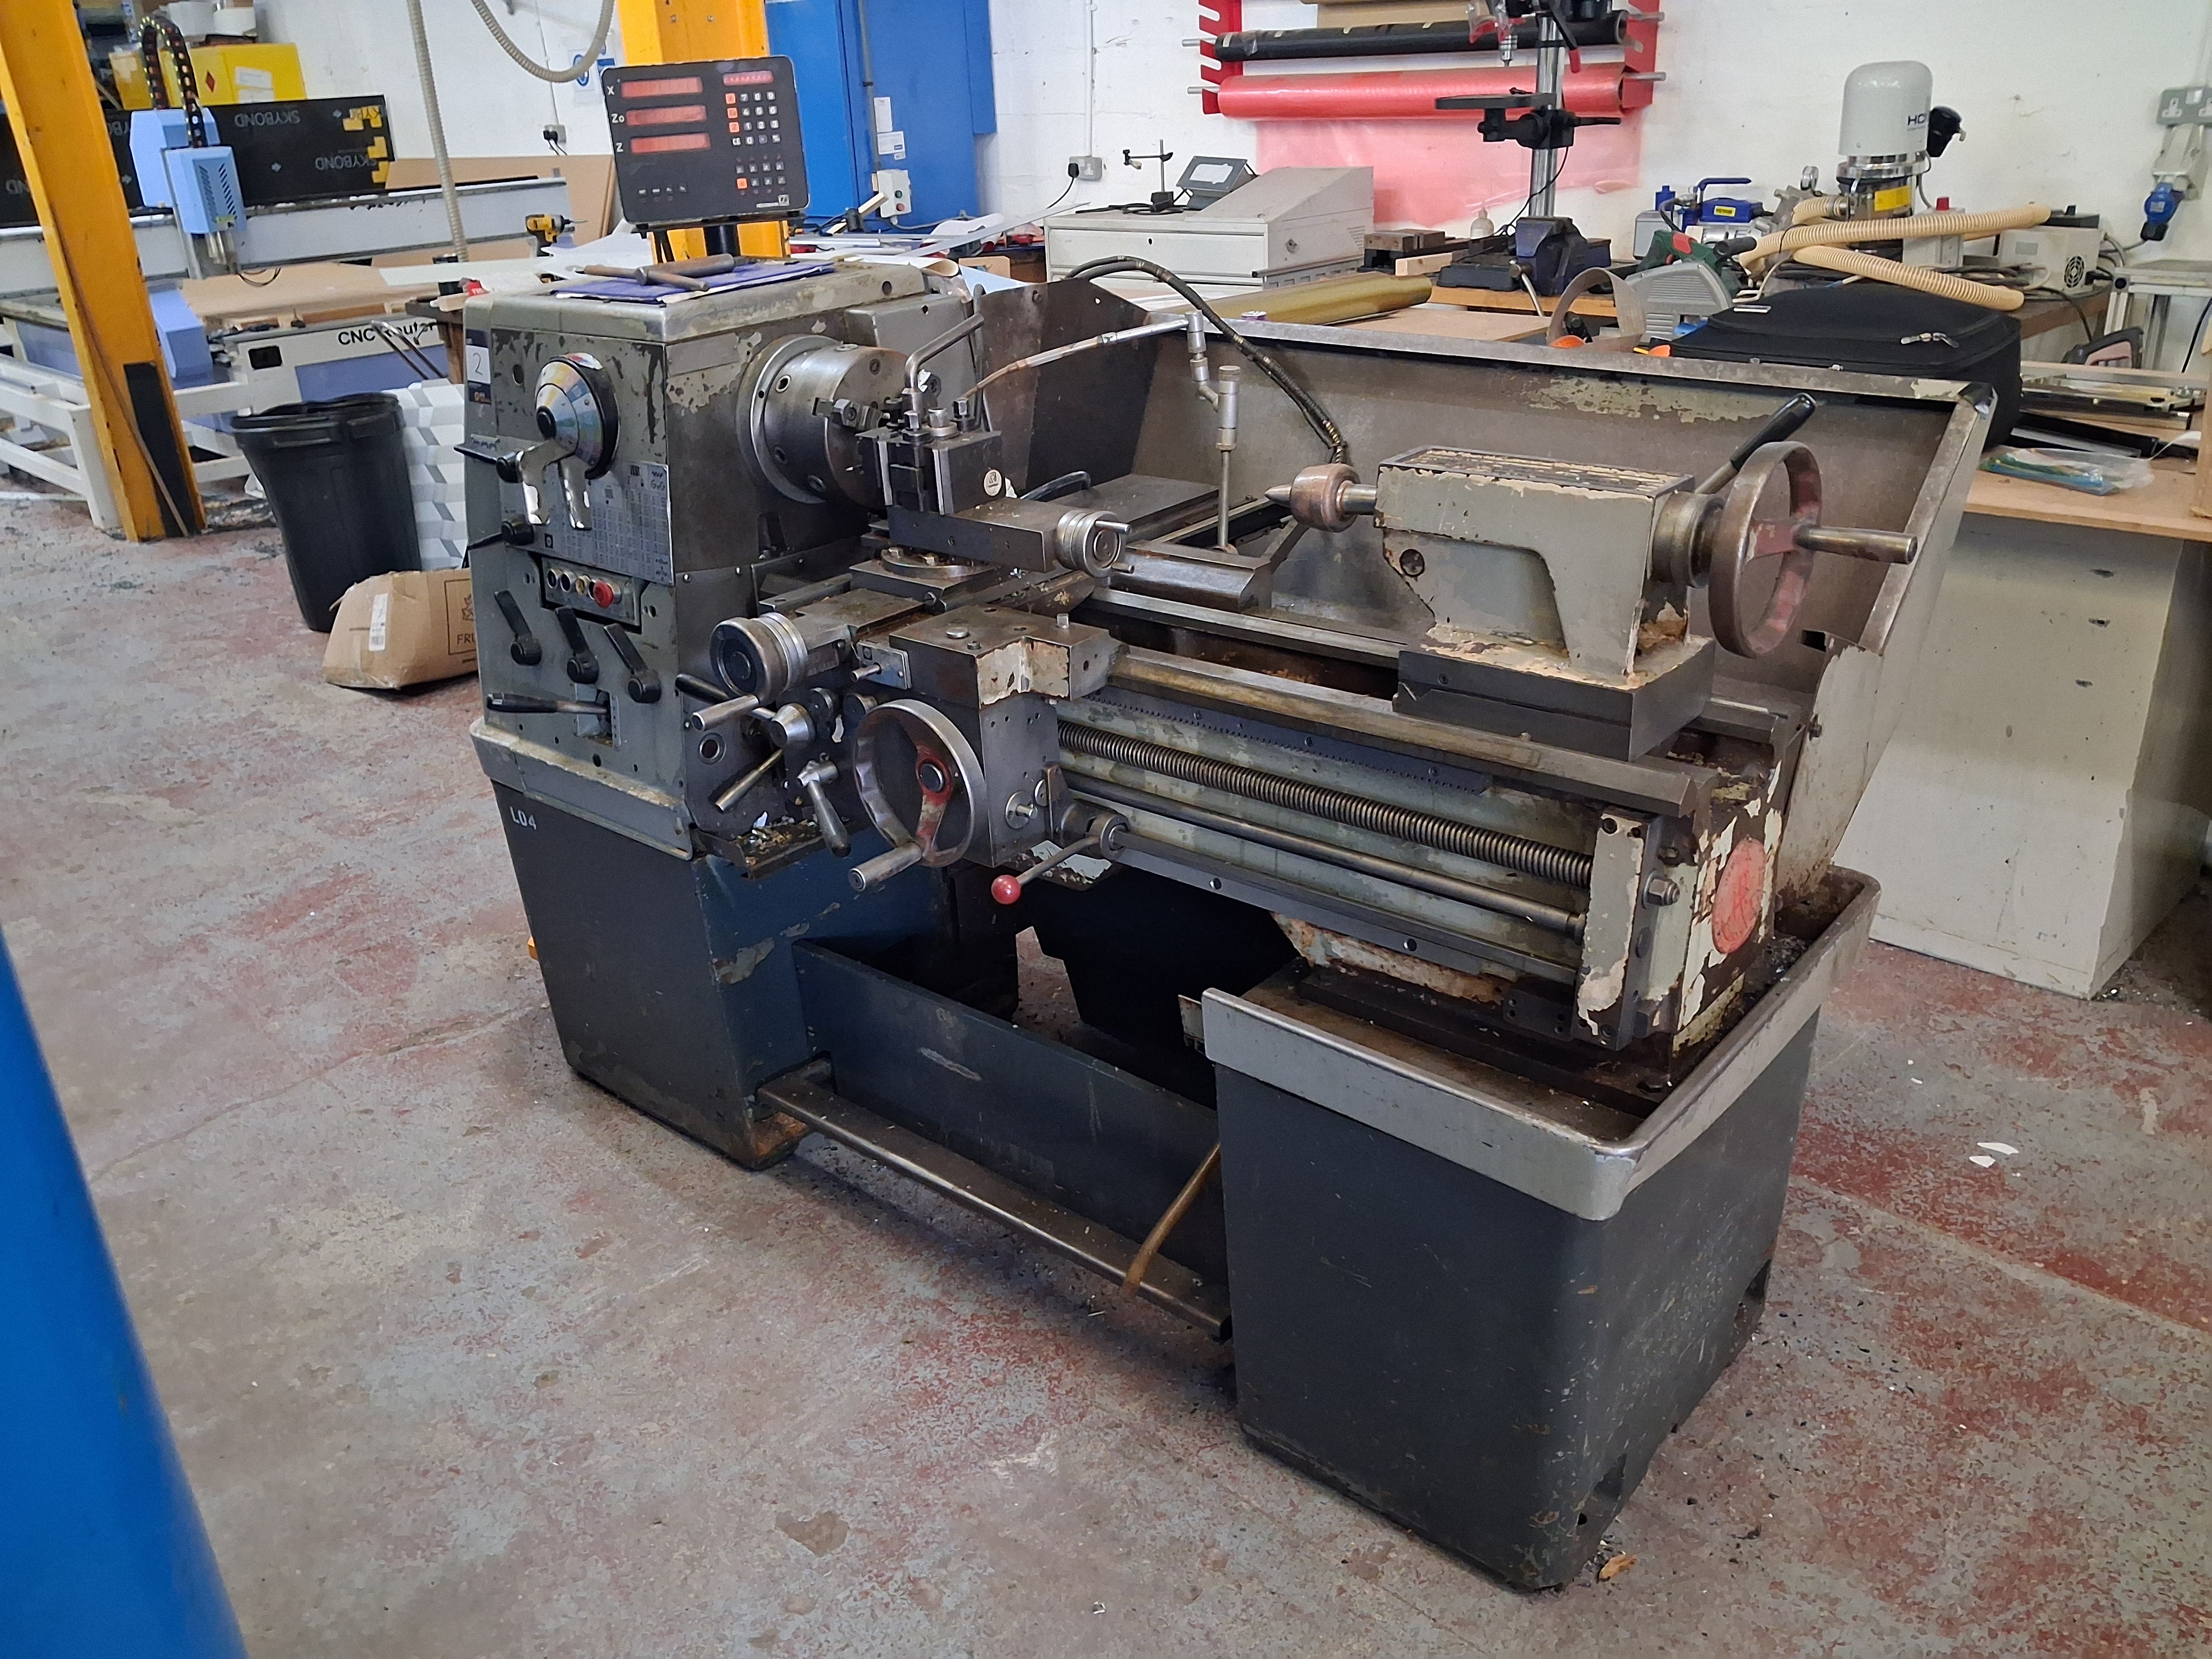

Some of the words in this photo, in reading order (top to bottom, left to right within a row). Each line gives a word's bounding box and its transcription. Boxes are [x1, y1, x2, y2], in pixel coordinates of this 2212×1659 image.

[607, 85, 615, 96] X
[234, 110, 300, 127] SKYBOND
[615, 142, 623, 153] Z
[338, 328, 376, 345] CNC
[473, 352, 483, 375] 2
